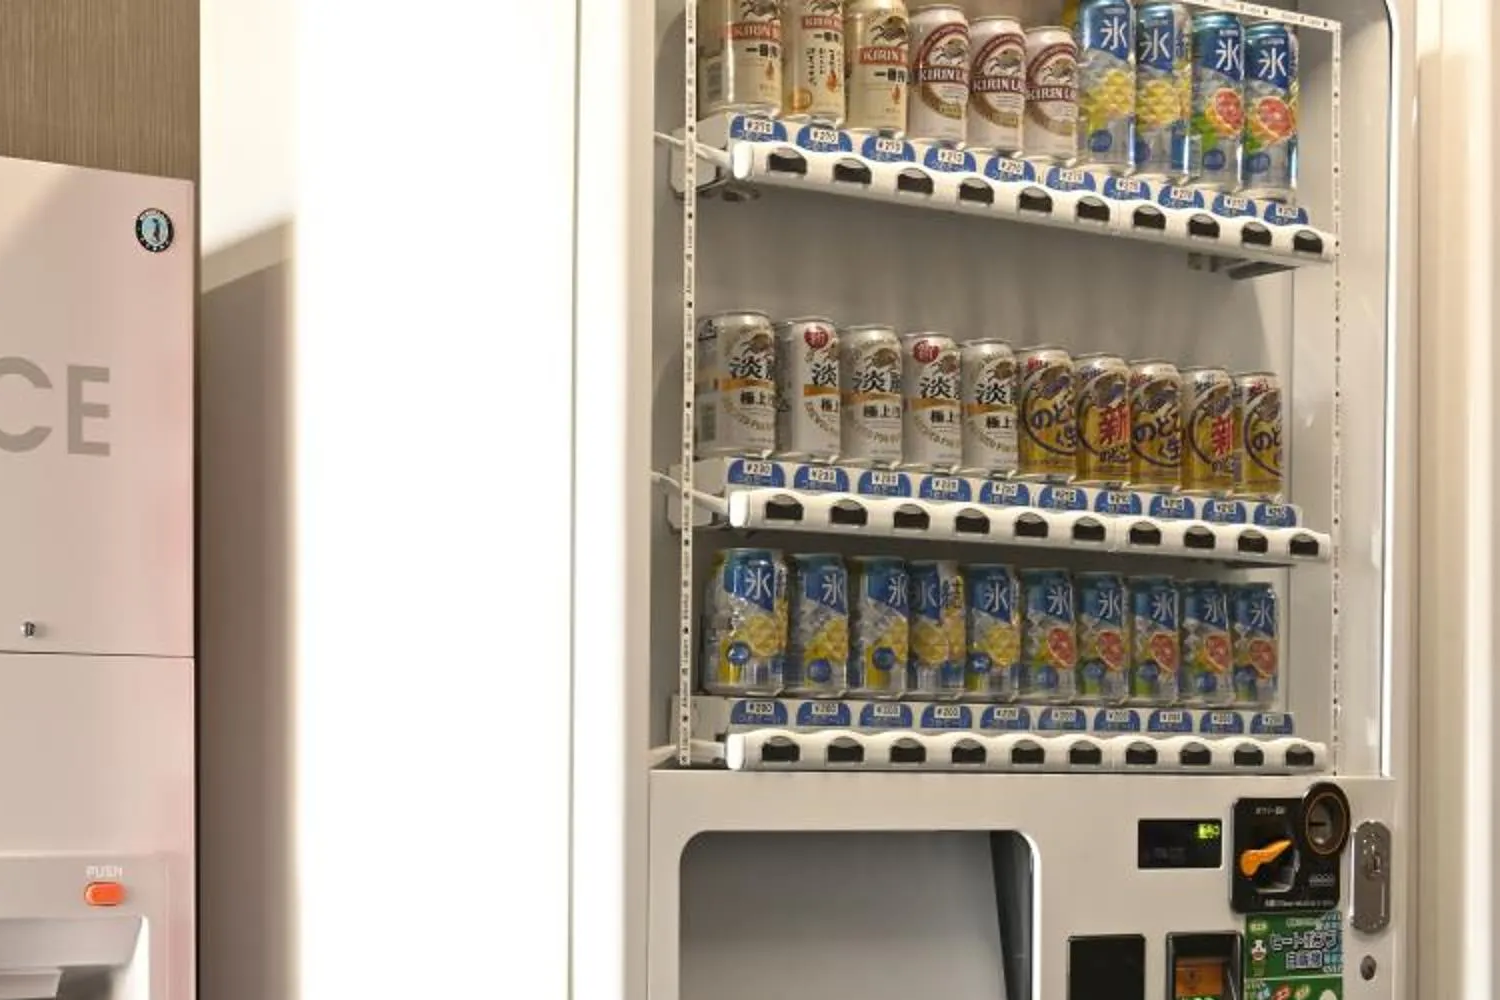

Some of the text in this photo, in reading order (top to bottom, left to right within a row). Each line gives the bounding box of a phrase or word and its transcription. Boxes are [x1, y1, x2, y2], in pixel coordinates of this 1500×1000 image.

[1101, 17, 1127, 49] 氷
[1140, 28, 1170, 62] 氷
[863, 47, 899, 61] KIRIN
[1216, 38, 1240, 71] 氷
[1258, 48, 1286, 79] 氷
[920, 68, 955, 81] KIRIN
[973, 78, 1010, 91] KIRIN
[1029, 88, 1063, 99] KIRIN
[729, 356, 772, 380] 淡
[745, 569, 771, 600] 氷
[822, 572, 844, 602] 氷
[888, 572, 906, 602] 氷
[984, 581, 1009, 610] 氷
[1050, 588, 1071, 615] 氷
[1100, 592, 1121, 620] 氷
[1152, 593, 1174, 621] 氷
[1204, 593, 1225, 621] 氷
[1252, 601, 1273, 627] 氷
[87, 865, 123, 878] PUSH
